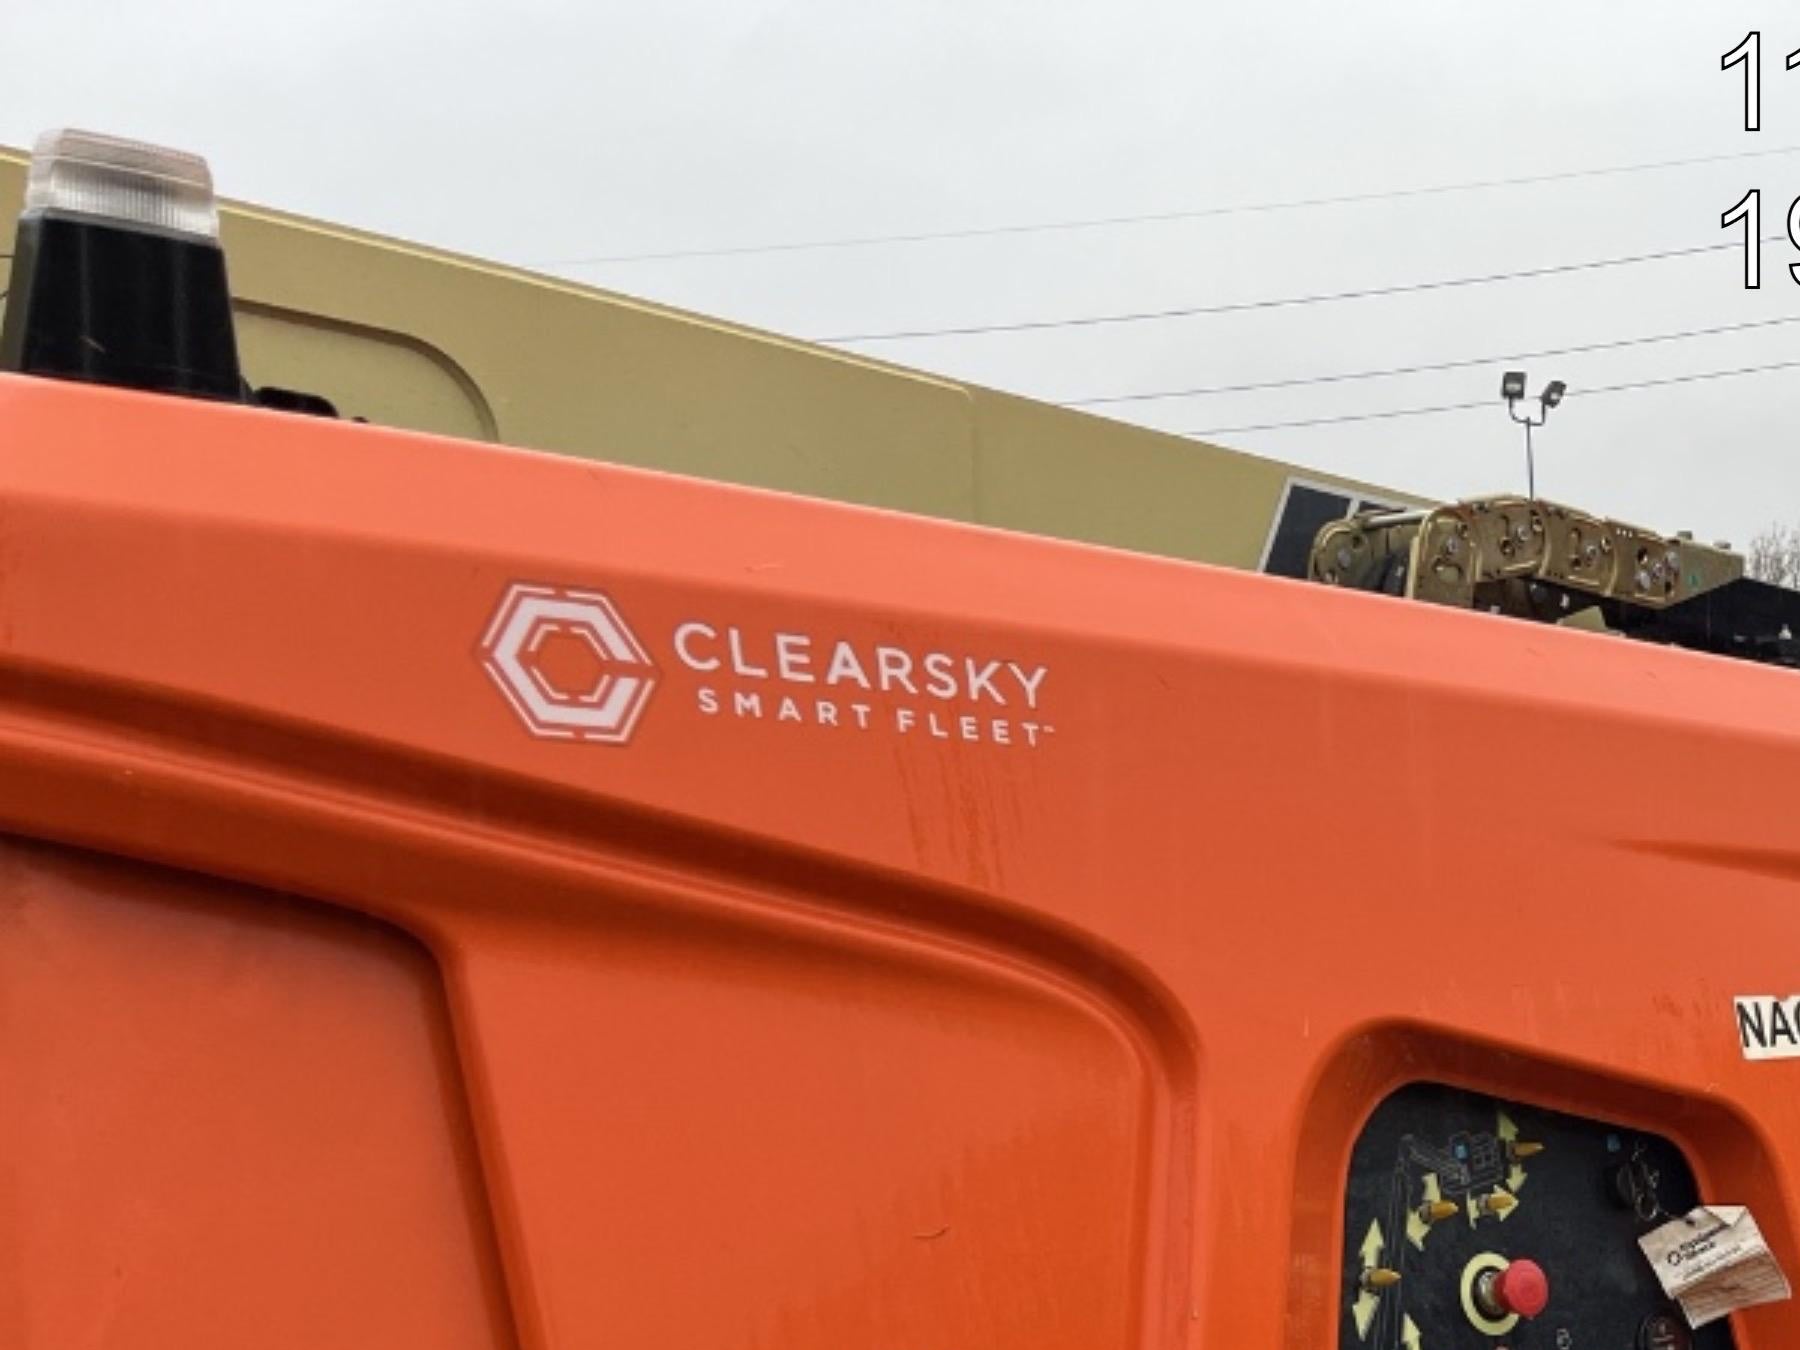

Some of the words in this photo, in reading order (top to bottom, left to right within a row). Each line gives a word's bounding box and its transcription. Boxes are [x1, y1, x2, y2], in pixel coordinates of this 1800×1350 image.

[673, 622, 1047, 709] CLEARSKY
[698, 688, 872, 729] SMART
[898, 709, 1054, 746] FLEET
